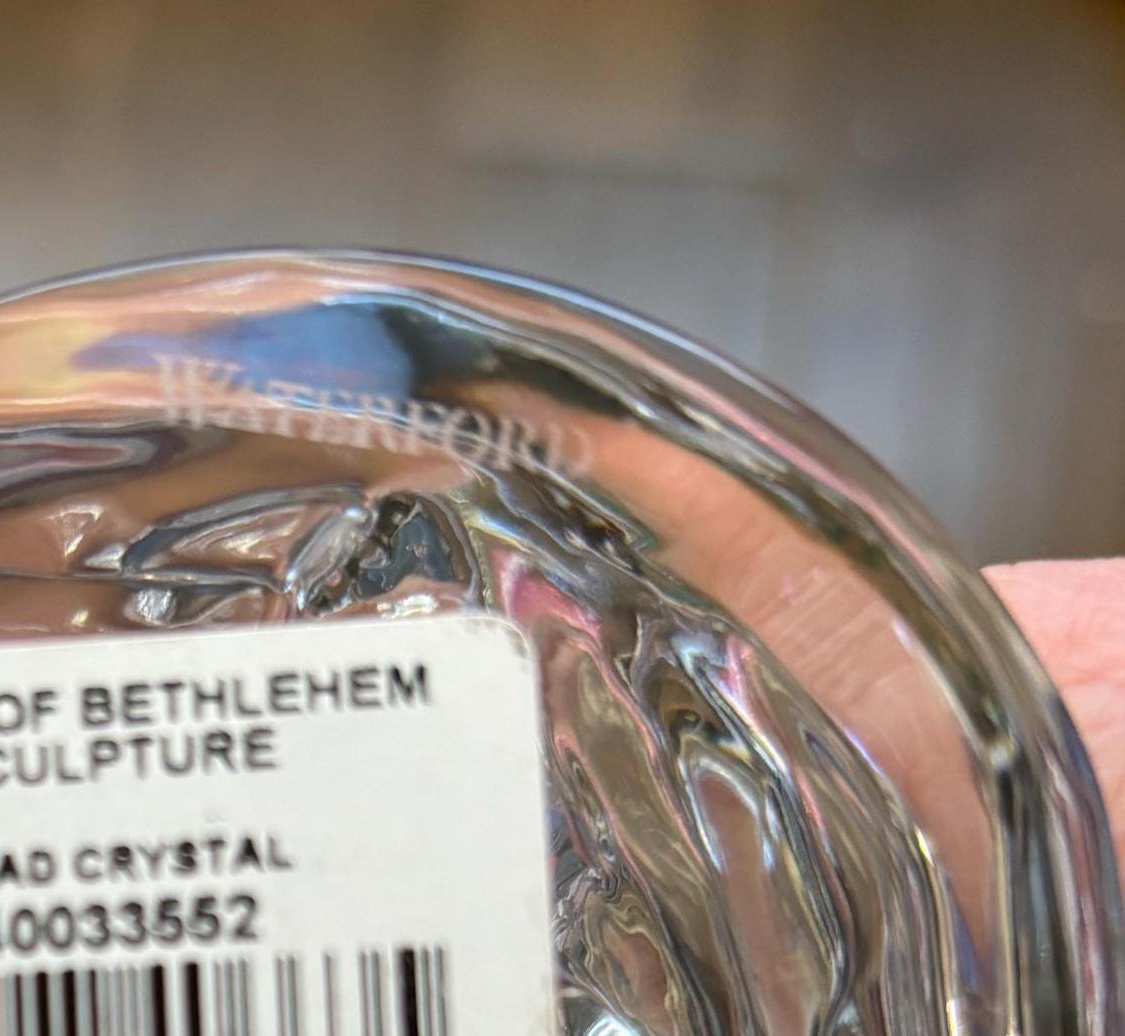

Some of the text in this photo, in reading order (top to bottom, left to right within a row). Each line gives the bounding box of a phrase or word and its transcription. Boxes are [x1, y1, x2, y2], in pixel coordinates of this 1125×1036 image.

[155, 353, 593, 474] WATERFORD
[81, 664, 431, 727] BETHLEHEM
[75, 834, 292, 882] CRYSTAL
